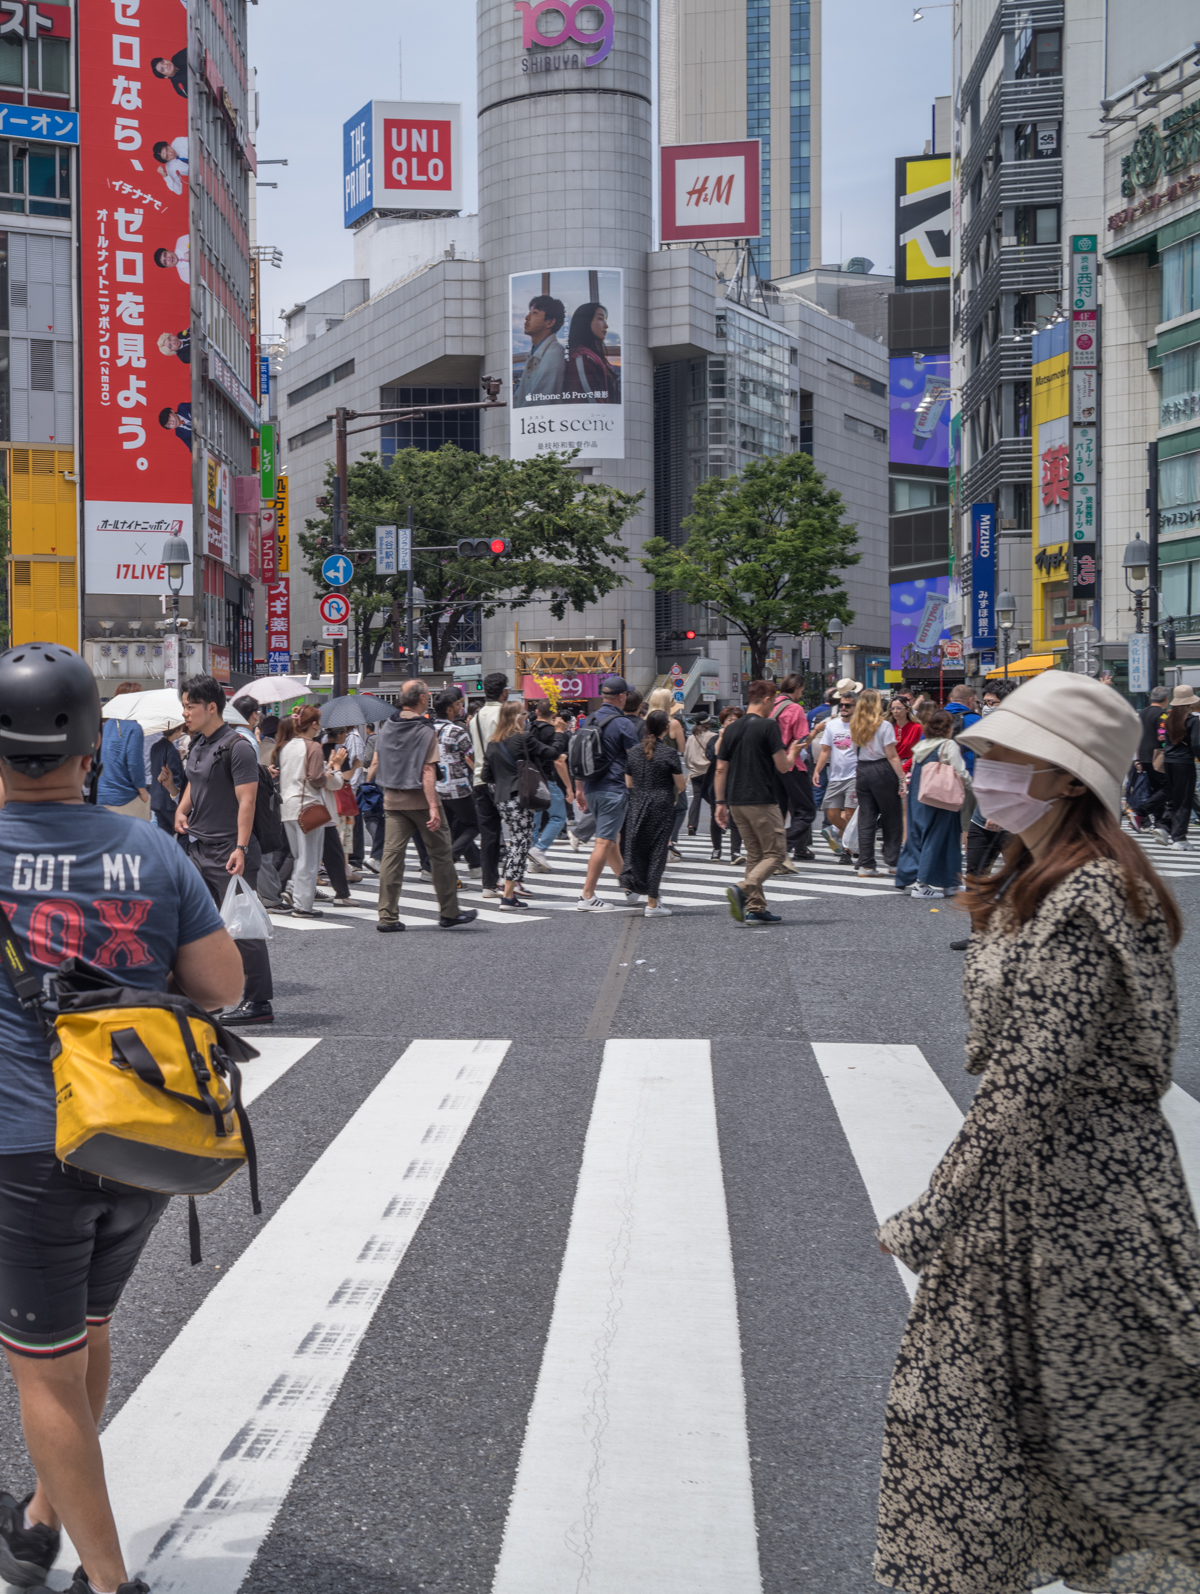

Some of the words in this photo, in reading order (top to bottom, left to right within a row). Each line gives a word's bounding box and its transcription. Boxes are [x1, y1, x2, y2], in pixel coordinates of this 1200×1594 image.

[514, 0, 614, 67] 109
[521, 54, 579, 73] SHIBUYA
[350, 122, 366, 167] THE
[391, 128, 439, 153] UNI
[346, 159, 371, 212] PRIME
[391, 157, 444, 185] QLO
[111, 179, 163, 210] イチナナで
[686, 174, 735, 207] H&M
[1079, 312, 1091, 320] 4F
[114, 207, 149, 472] ゼロを見よう。
[532, 392, 560, 401] iPhone
[561, 391, 571, 399] 16
[520, 418, 556, 435] last
[560, 419, 614, 432] scene
[263, 449, 272, 472] レイク
[1075, 443, 1084, 471] パーラー
[1085, 438, 1094, 467] フルーツ
[1042, 442, 1070, 506] 薬
[1075, 500, 1084, 529] フルーツ
[1085, 496, 1093, 526] 渋谷西村
[384, 529, 394, 570] 渋谷駅前
[979, 514, 991, 558] MIZUHO
[263, 540, 274, 569] アコム
[1078, 555, 1096, 585] HUB
[270, 581, 289, 648] スギ薬局
[918, 602, 941, 643] EUTHYMOL
[977, 590, 989, 637] みずほ銀行
[102, 645, 196, 657] 渋谷駅前ル
[269, 652, 280, 662] 24
[1132, 638, 1141, 683] 文化村通り
[270, 664, 289, 673] 営業
[556, 678, 583, 697] 09
[12, 853, 77, 892] GOT
[102, 851, 141, 892] MY
